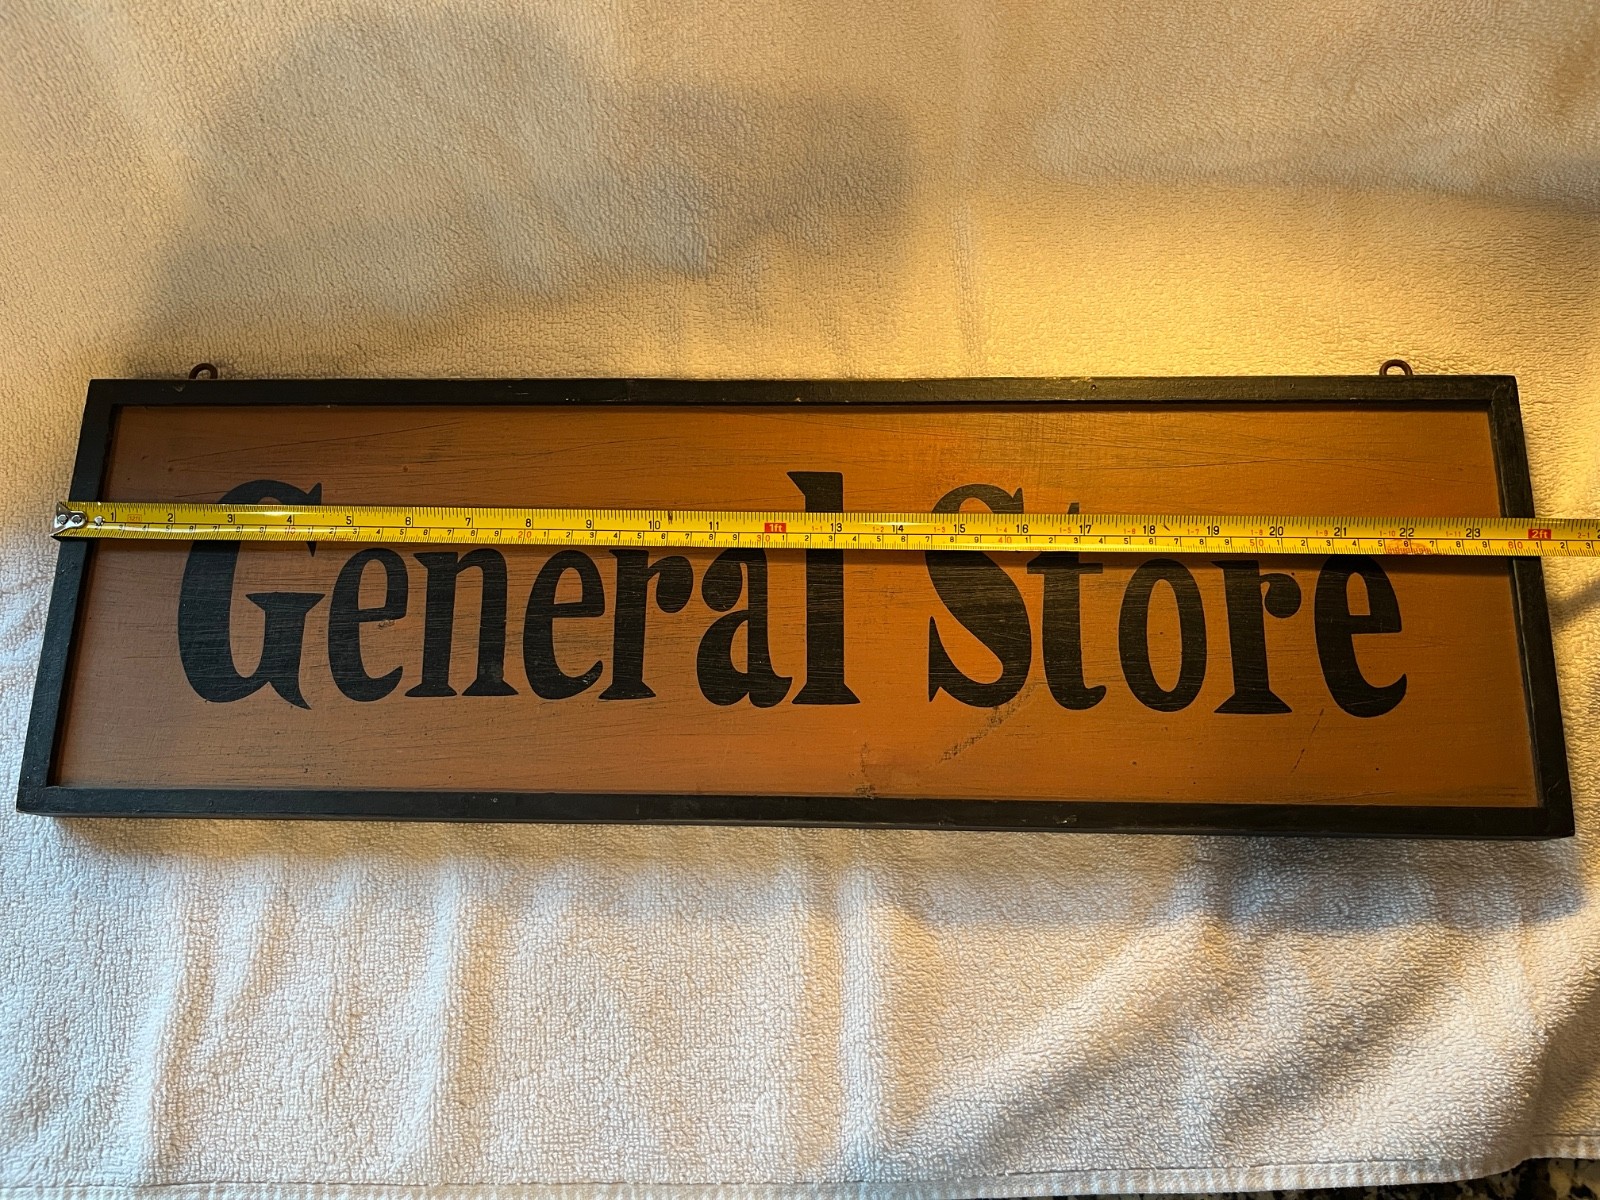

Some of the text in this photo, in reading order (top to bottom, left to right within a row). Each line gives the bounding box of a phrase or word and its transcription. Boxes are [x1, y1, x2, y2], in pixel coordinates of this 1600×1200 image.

[167, 513, 174, 522] 2
[227, 514, 233, 523] 3
[286, 515, 292, 524] 4
[346, 516, 352, 525] 5
[405, 517, 411, 525] 6
[465, 518, 471, 527] 7
[525, 518, 532, 528] 8
[586, 520, 592, 529] 9
[648, 520, 661, 530] 10
[709, 521, 720, 530] 11
[769, 524, 783, 532] 1ft
[830, 523, 843, 532] 13
[892, 524, 904, 533] 14
[953, 524, 966, 533] 15
[1016, 525, 1028, 534] 16
[1079, 525, 1092, 534] 17
[1143, 525, 1156, 534] 18
[1206, 526, 1220, 535] 19
[1269, 526, 1284, 536] 20
[1334, 527, 1346, 536] 21
[1399, 527, 1415, 537] 22
[1466, 528, 1481, 538] 23
[1531, 530, 1548, 539] 2ft
[177, 471, 1408, 718] General Store
